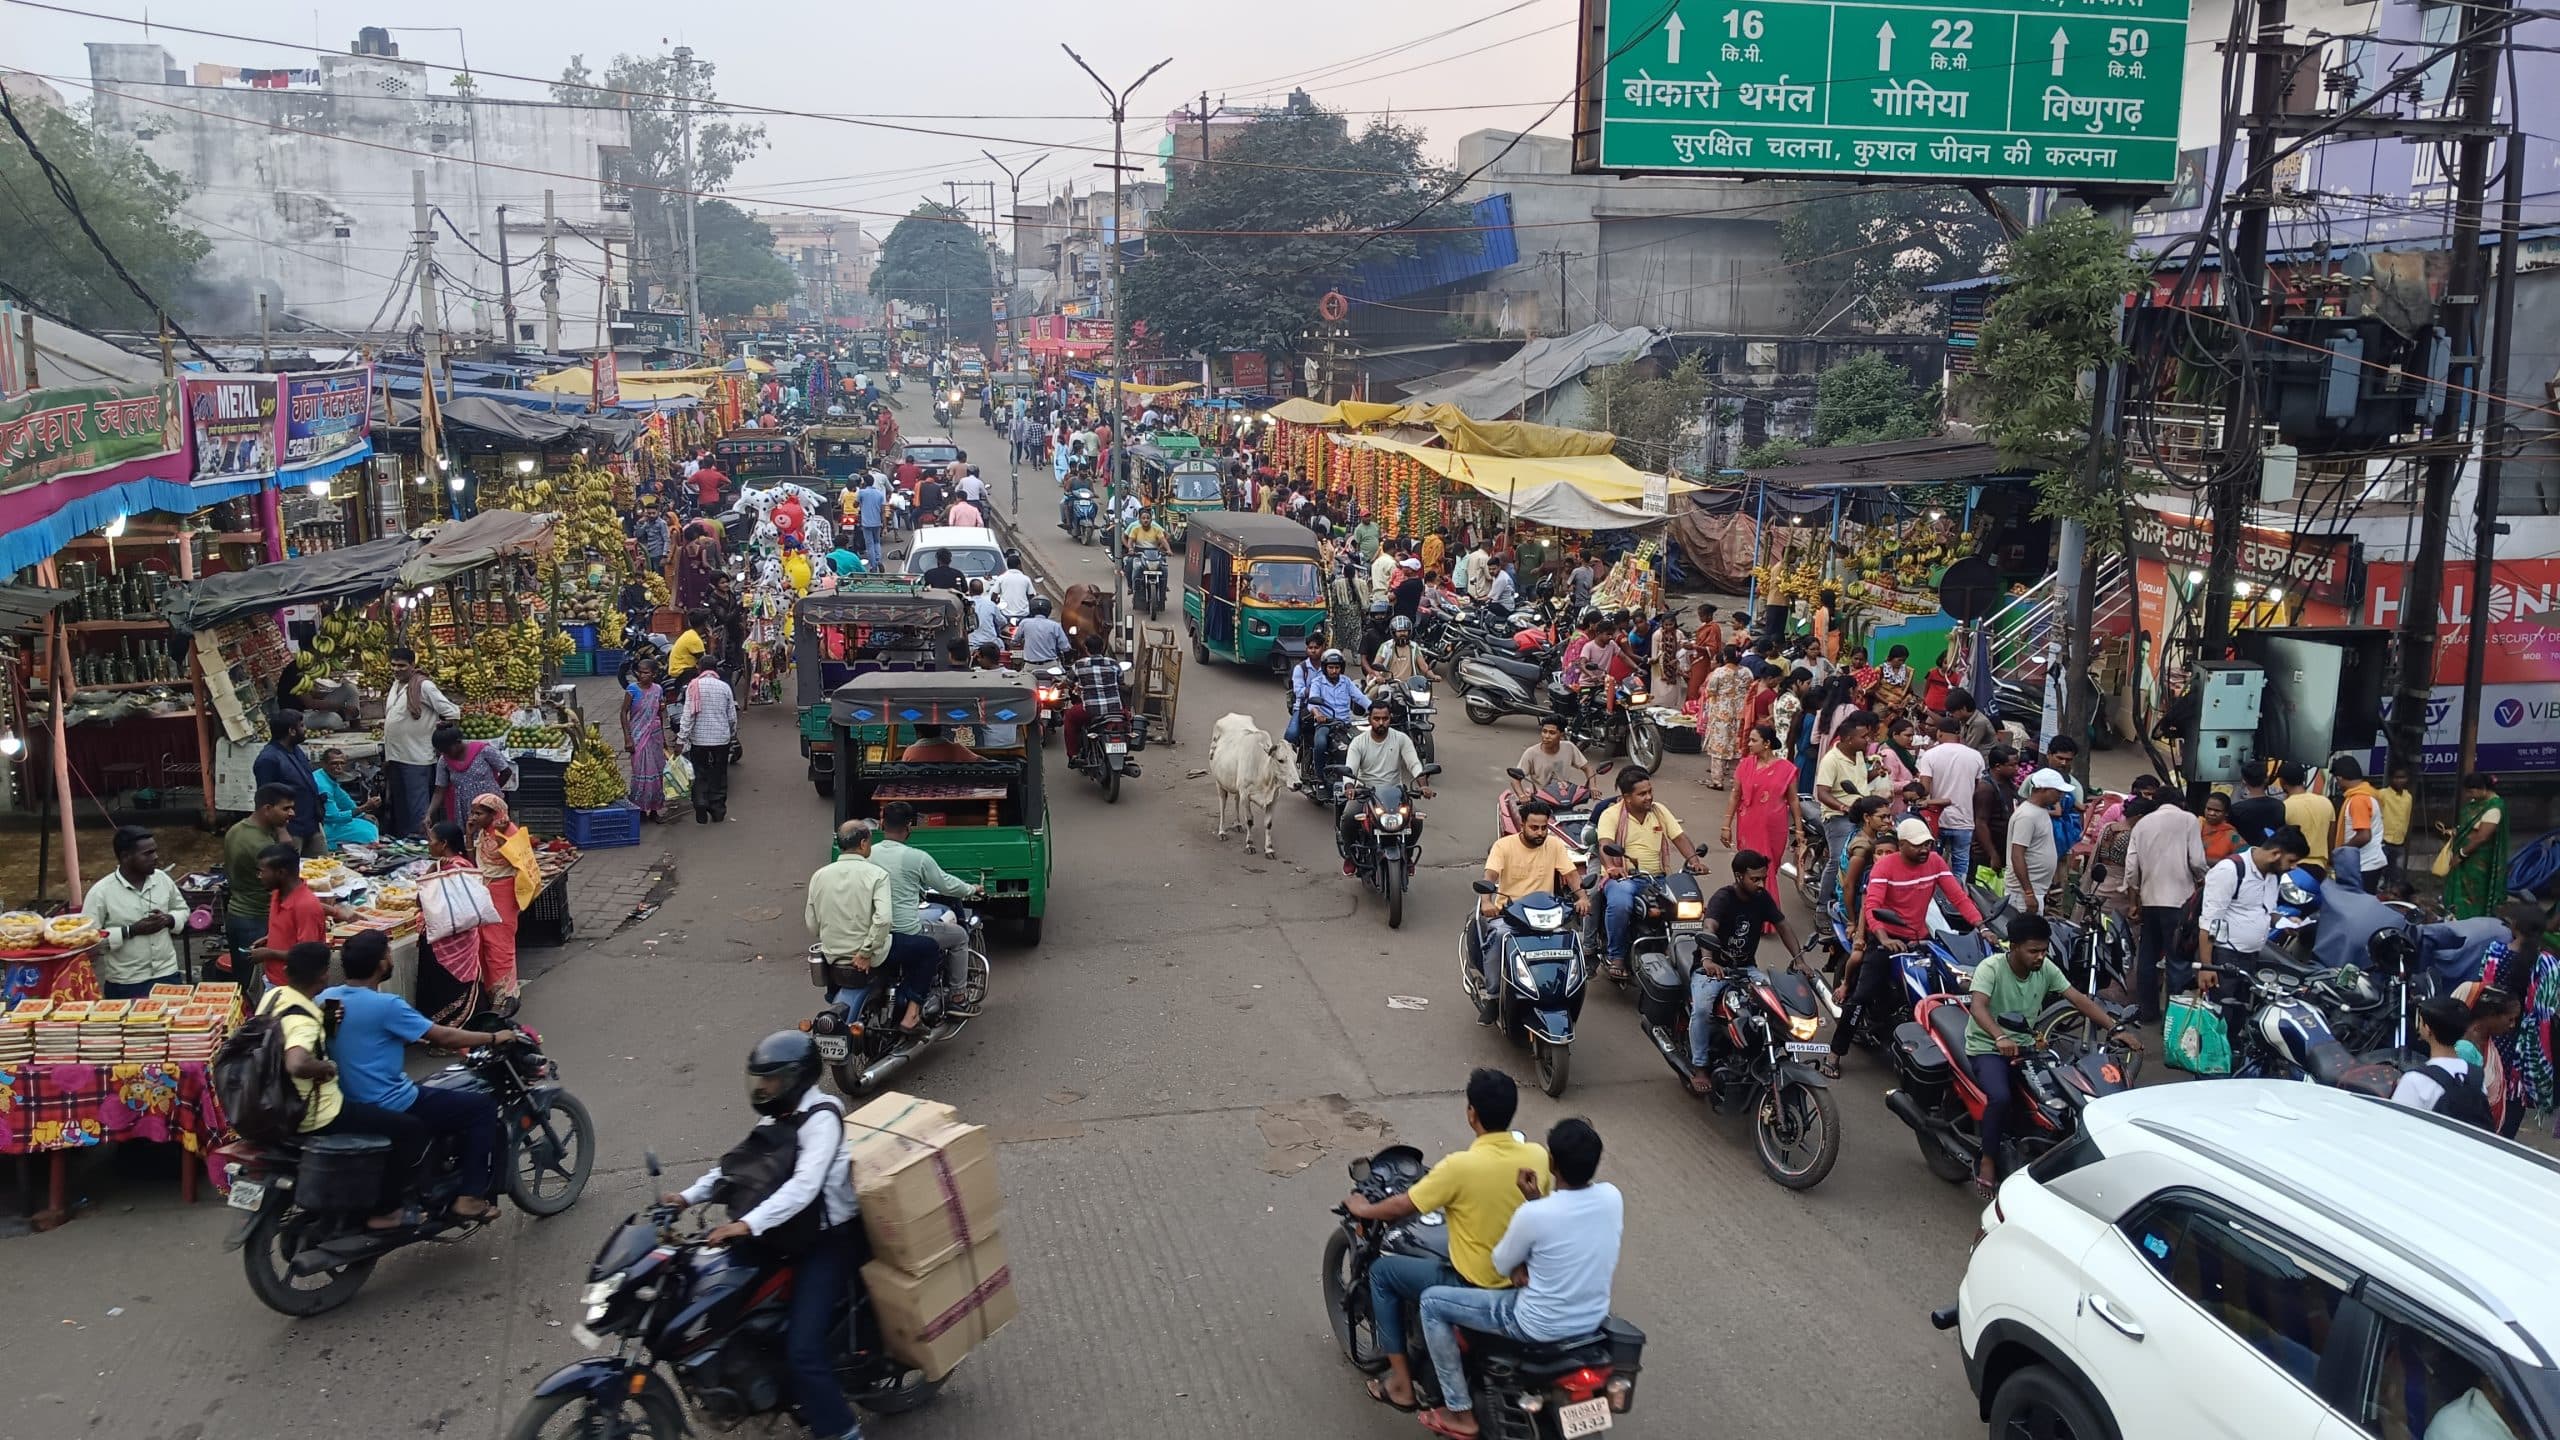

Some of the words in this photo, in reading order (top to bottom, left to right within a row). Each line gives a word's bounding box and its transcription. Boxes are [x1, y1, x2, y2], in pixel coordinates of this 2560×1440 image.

[1722, 9, 1764, 39] 16
[1929, 19, 1973, 49] 22
[1721, 43, 1763, 63] कि.मी.
[2107, 27, 2149, 57] 50
[1930, 52, 1970, 72] कि.मी.
[2108, 60, 2146, 80] कि.मी.
[1622, 68, 1722, 109] बोकारो
[1738, 74, 1815, 113] थर्मल
[1871, 78, 1969, 117] गोमिया
[2042, 85, 2145, 132] विष्णुगढ़
[1671, 128, 1753, 163] सुरक्षित
[1766, 138, 1841, 161] चलना,
[1853, 140, 1917, 167] कुशल
[1929, 136, 1990, 164] जीवन
[2003, 138, 2032, 165] की
[2045, 147, 2118, 168] कल्पना
[217, 385, 259, 419] METAL
[292, 384, 320, 423] गंगा
